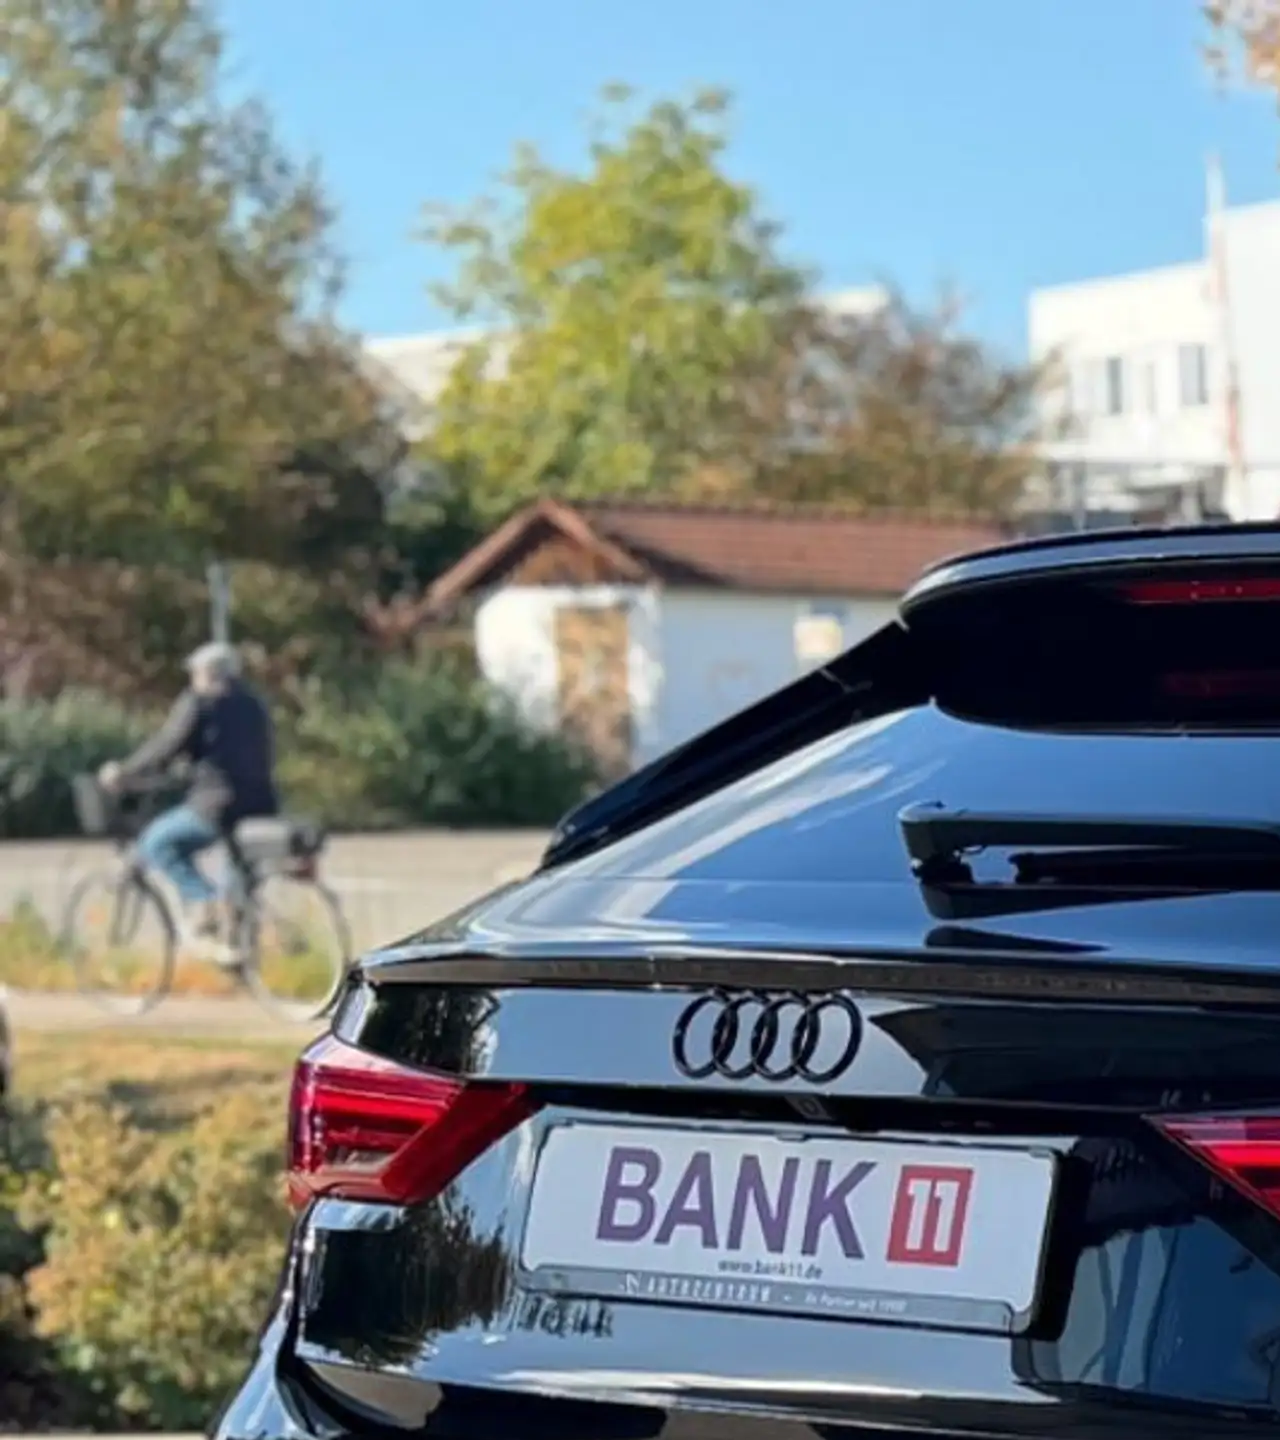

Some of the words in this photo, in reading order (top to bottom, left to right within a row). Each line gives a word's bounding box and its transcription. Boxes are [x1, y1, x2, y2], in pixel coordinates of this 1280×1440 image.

[595, 1146, 878, 1260] BANK
[902, 1176, 964, 1256] 11
[717, 1258, 823, 1279] www.bank11.de
